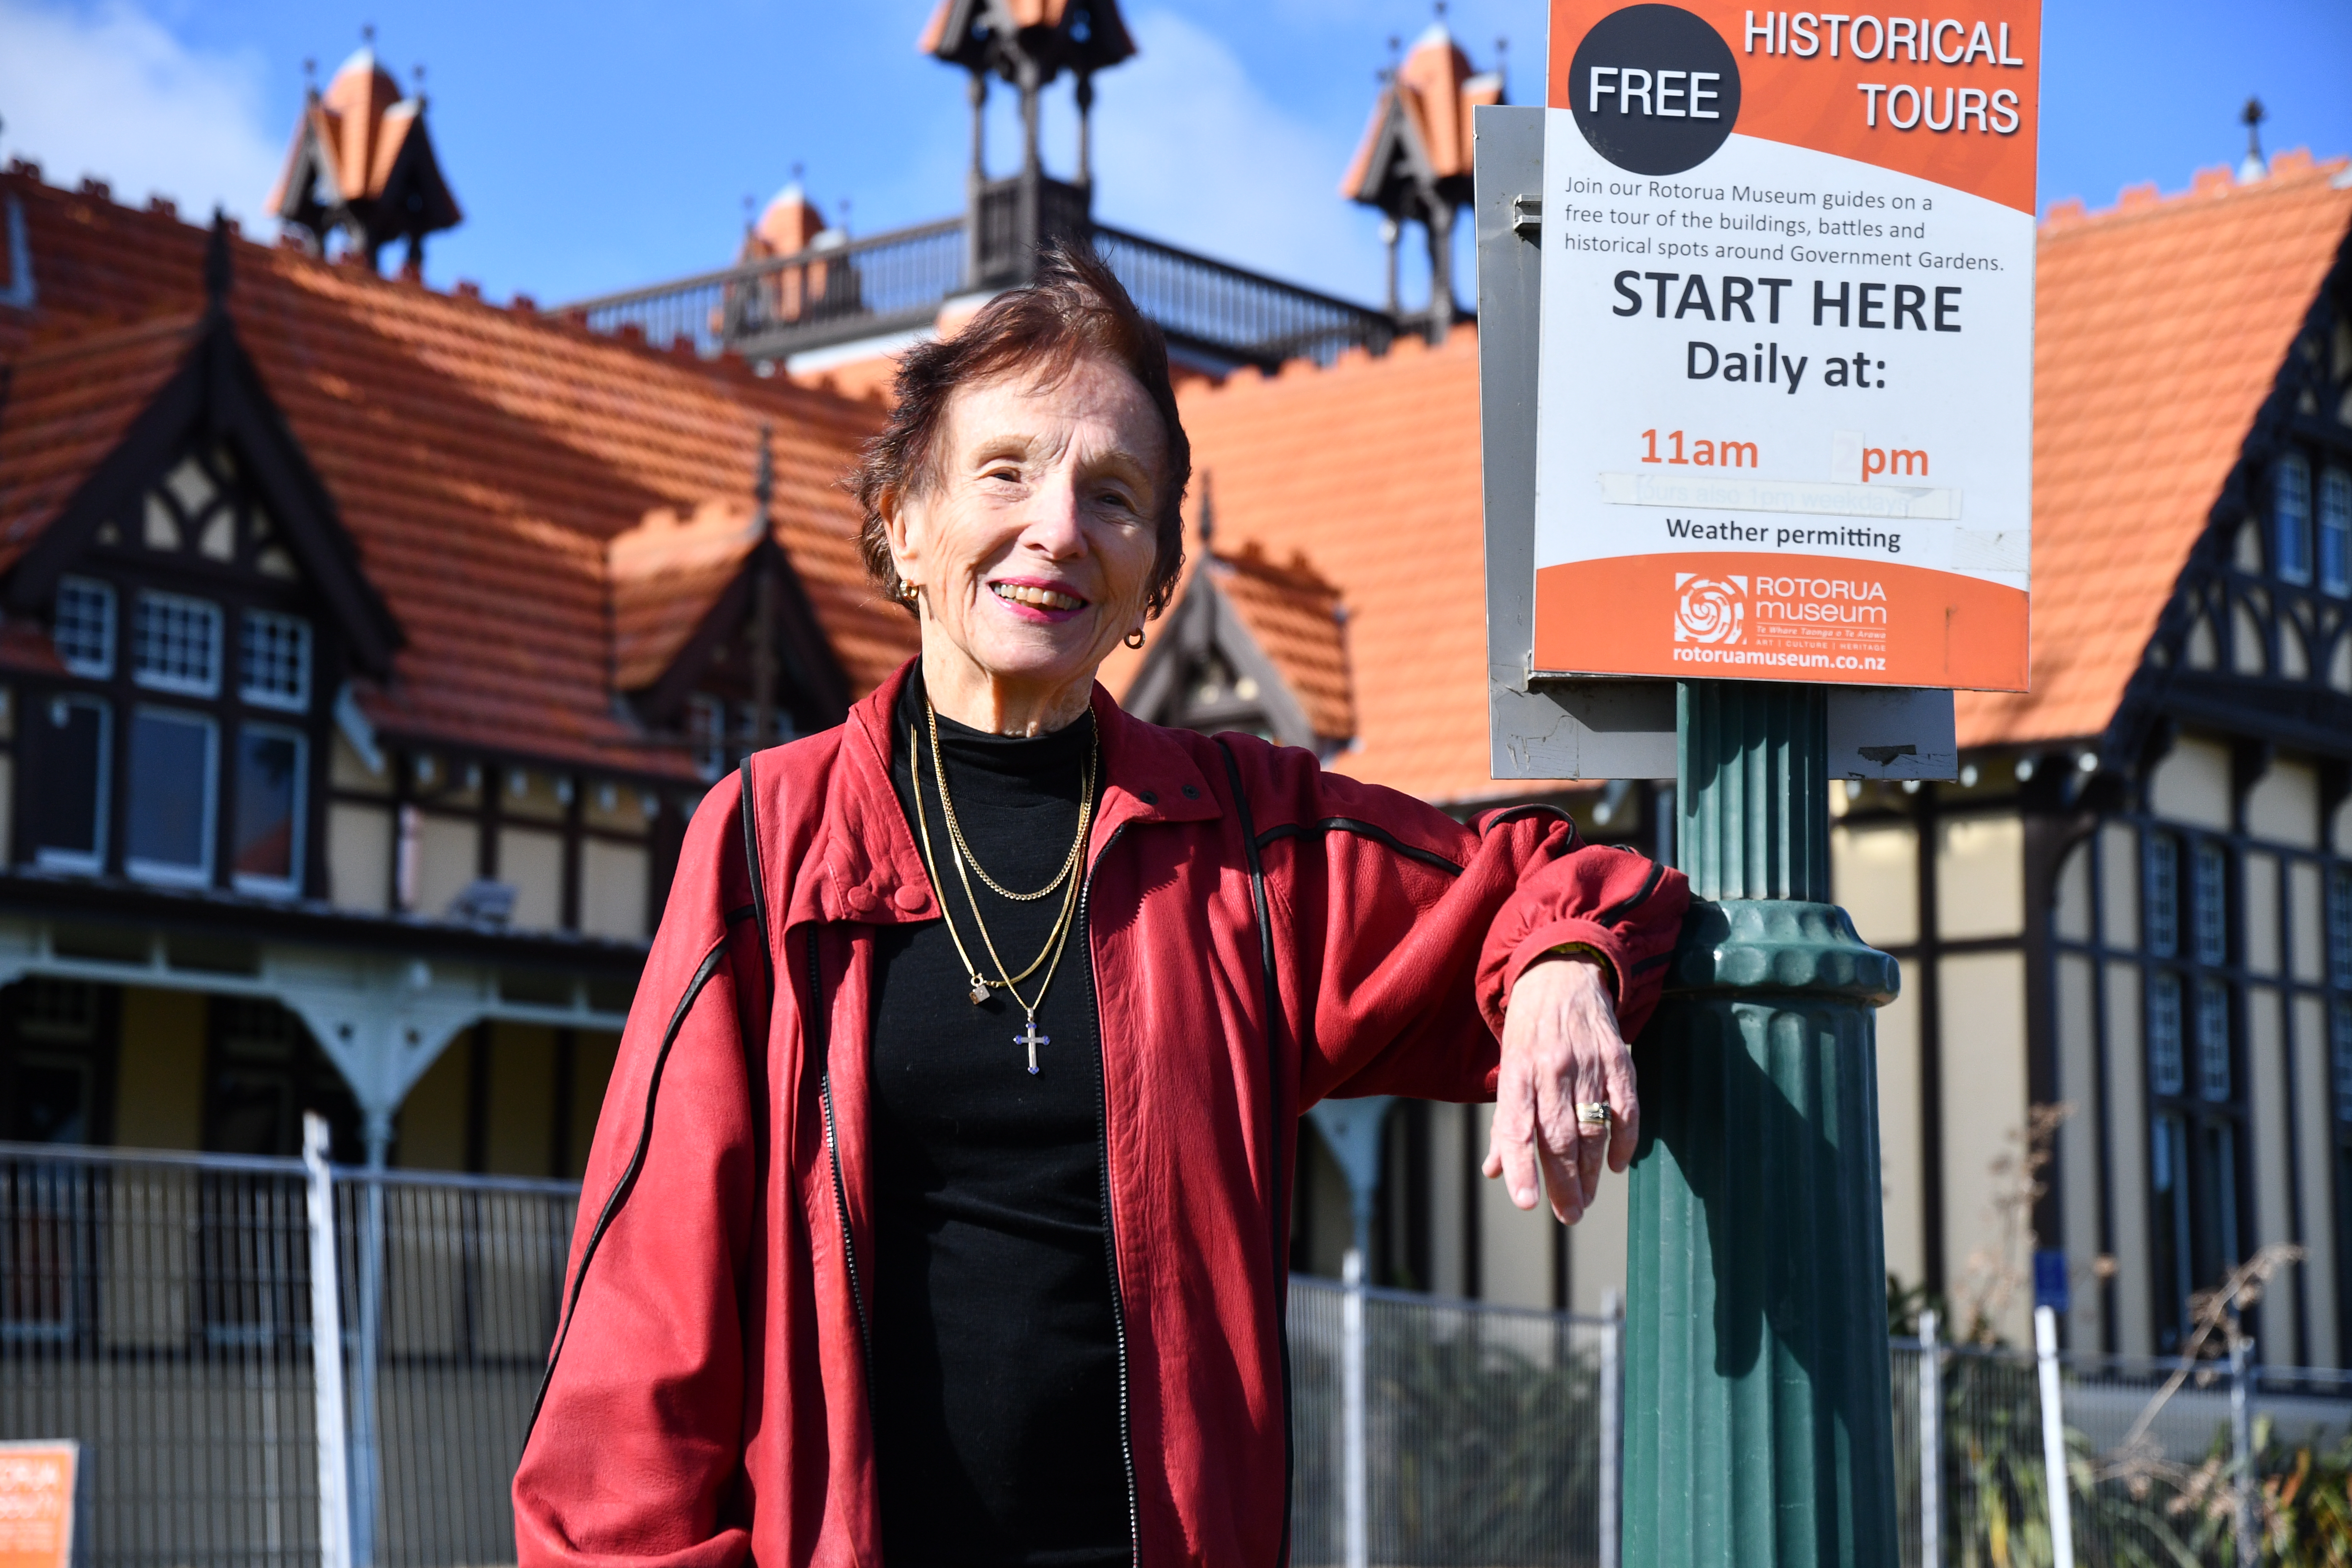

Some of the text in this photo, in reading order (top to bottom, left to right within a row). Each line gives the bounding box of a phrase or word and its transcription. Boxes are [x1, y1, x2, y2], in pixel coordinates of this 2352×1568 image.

[1745, 10, 2023, 65] HISTORICAL
[1589, 66, 1720, 119] FREE
[1857, 83, 2019, 133] TOURS
[1565, 177, 1932, 211] Join our Rotorua Museum guides on a
[1565, 204, 1924, 239] free tour of the buildings, battles and
[1565, 233, 2004, 272] historical spots around Government Gardens.
[1612, 270, 1962, 333] START HERE
[1687, 341, 1885, 395] Daily at:
[1642, 429, 1758, 468] 11am
[1666, 518, 1901, 553] Weather permitting
[1756, 576, 1887, 602] ROTORUA
[1756, 601, 1887, 624] museum
[1769, 626, 1797, 635] Whare
[1801, 628, 1833, 638] Taonga
[1857, 631, 1886, 639] Arawa
[1786, 640, 1828, 649] CULTURE
[1840, 644, 1886, 652] HERITAGE
[1673, 646, 1886, 671] rotoruamuseum.co.nz
